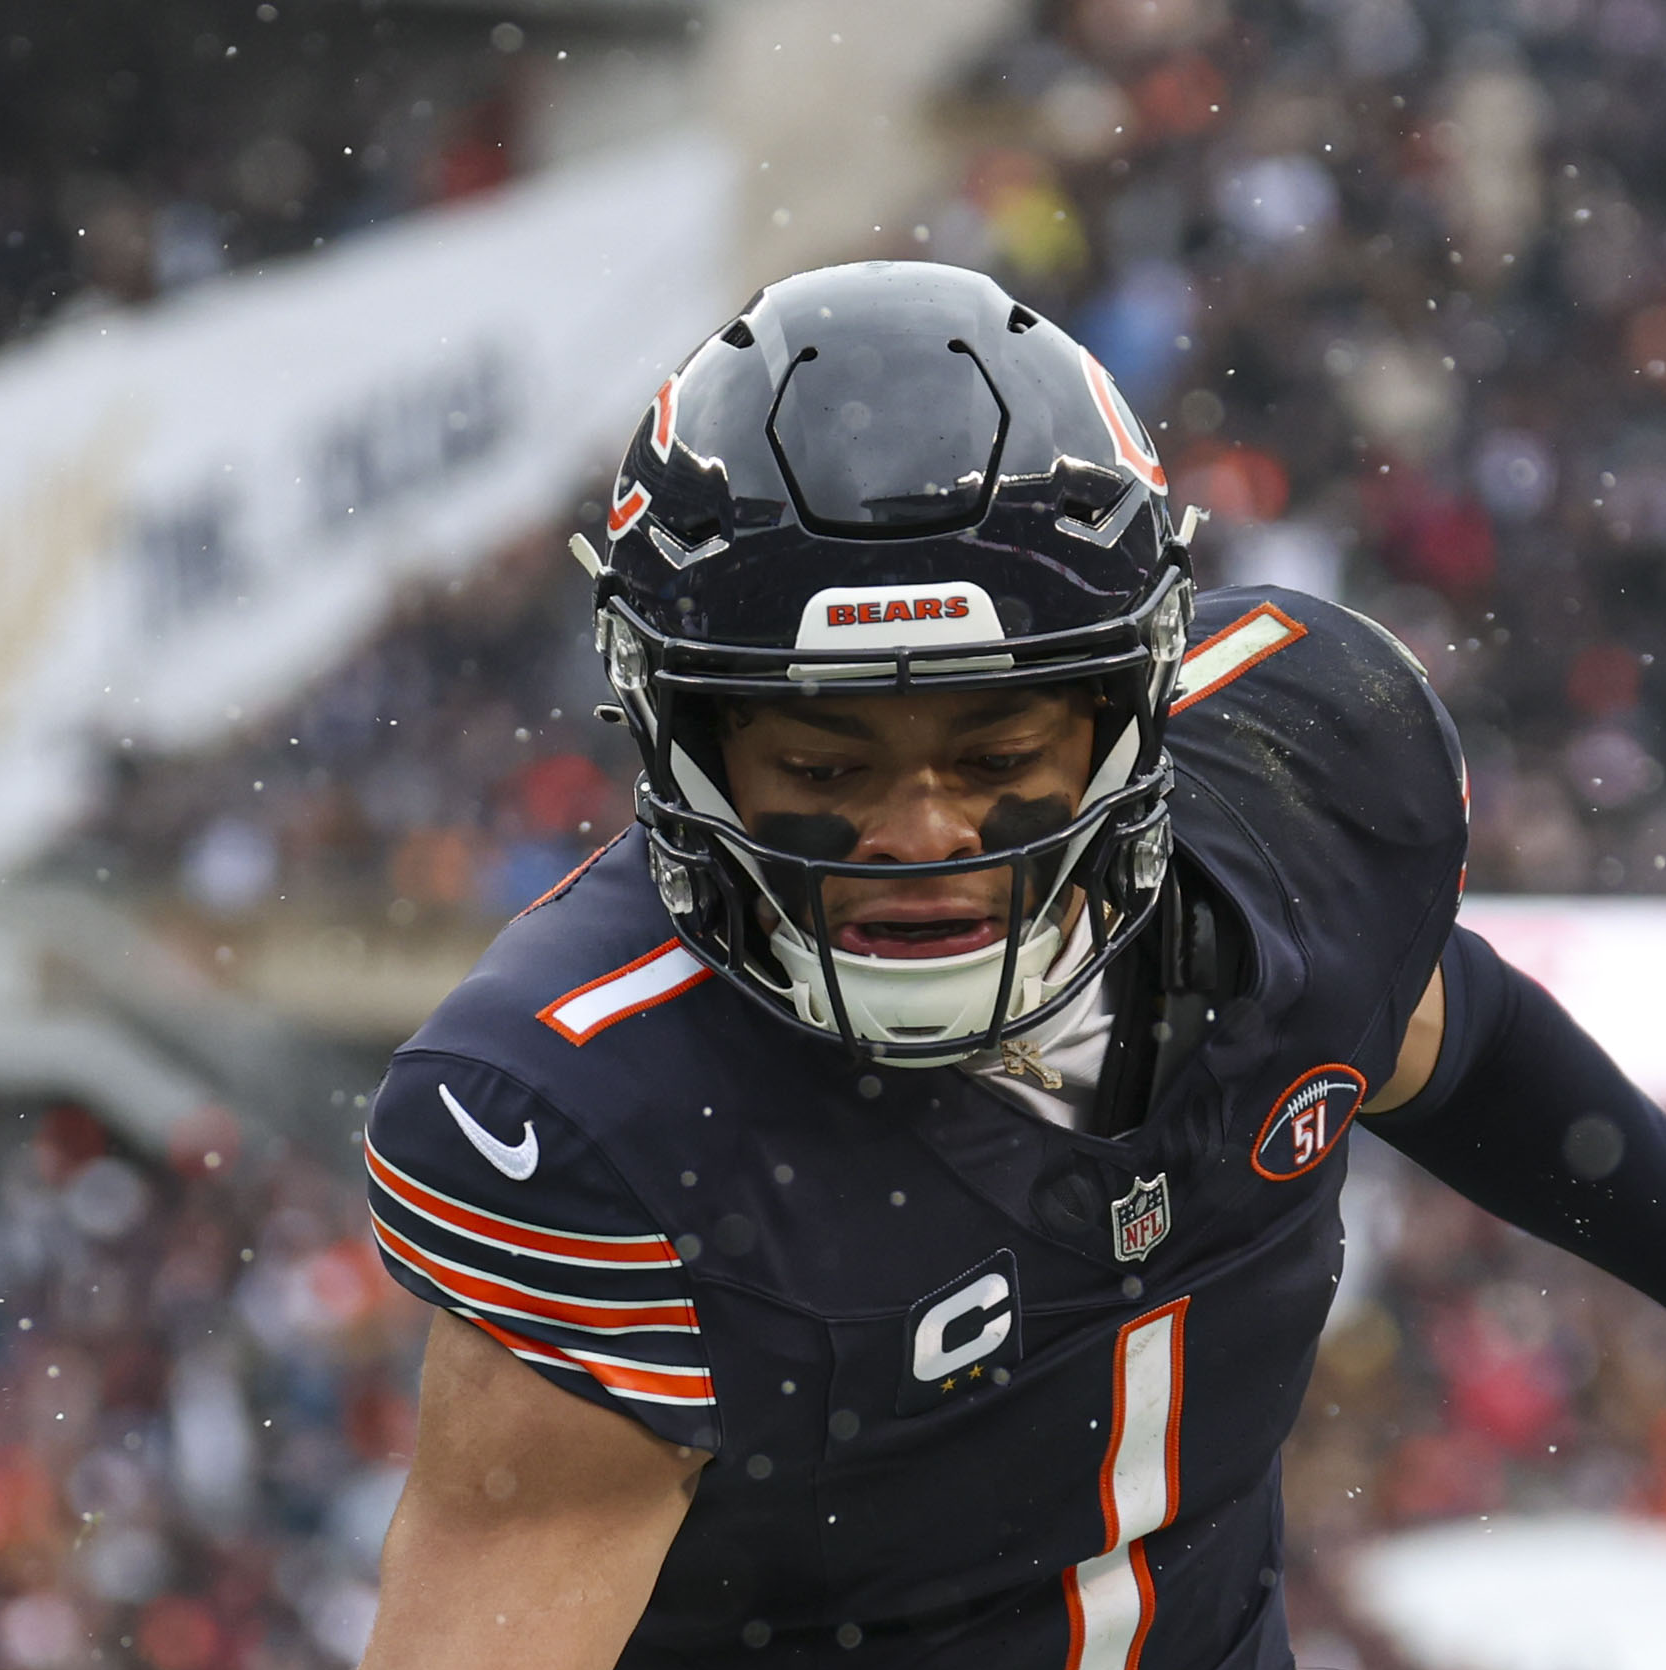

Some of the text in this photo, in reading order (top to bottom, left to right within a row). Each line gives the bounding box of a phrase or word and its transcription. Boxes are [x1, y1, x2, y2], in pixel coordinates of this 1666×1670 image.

[827, 597, 970, 627] BEARS
[1290, 1099, 1327, 1165] 51
[1124, 1210, 1163, 1251] NFL
[913, 1273, 1012, 1382] C
